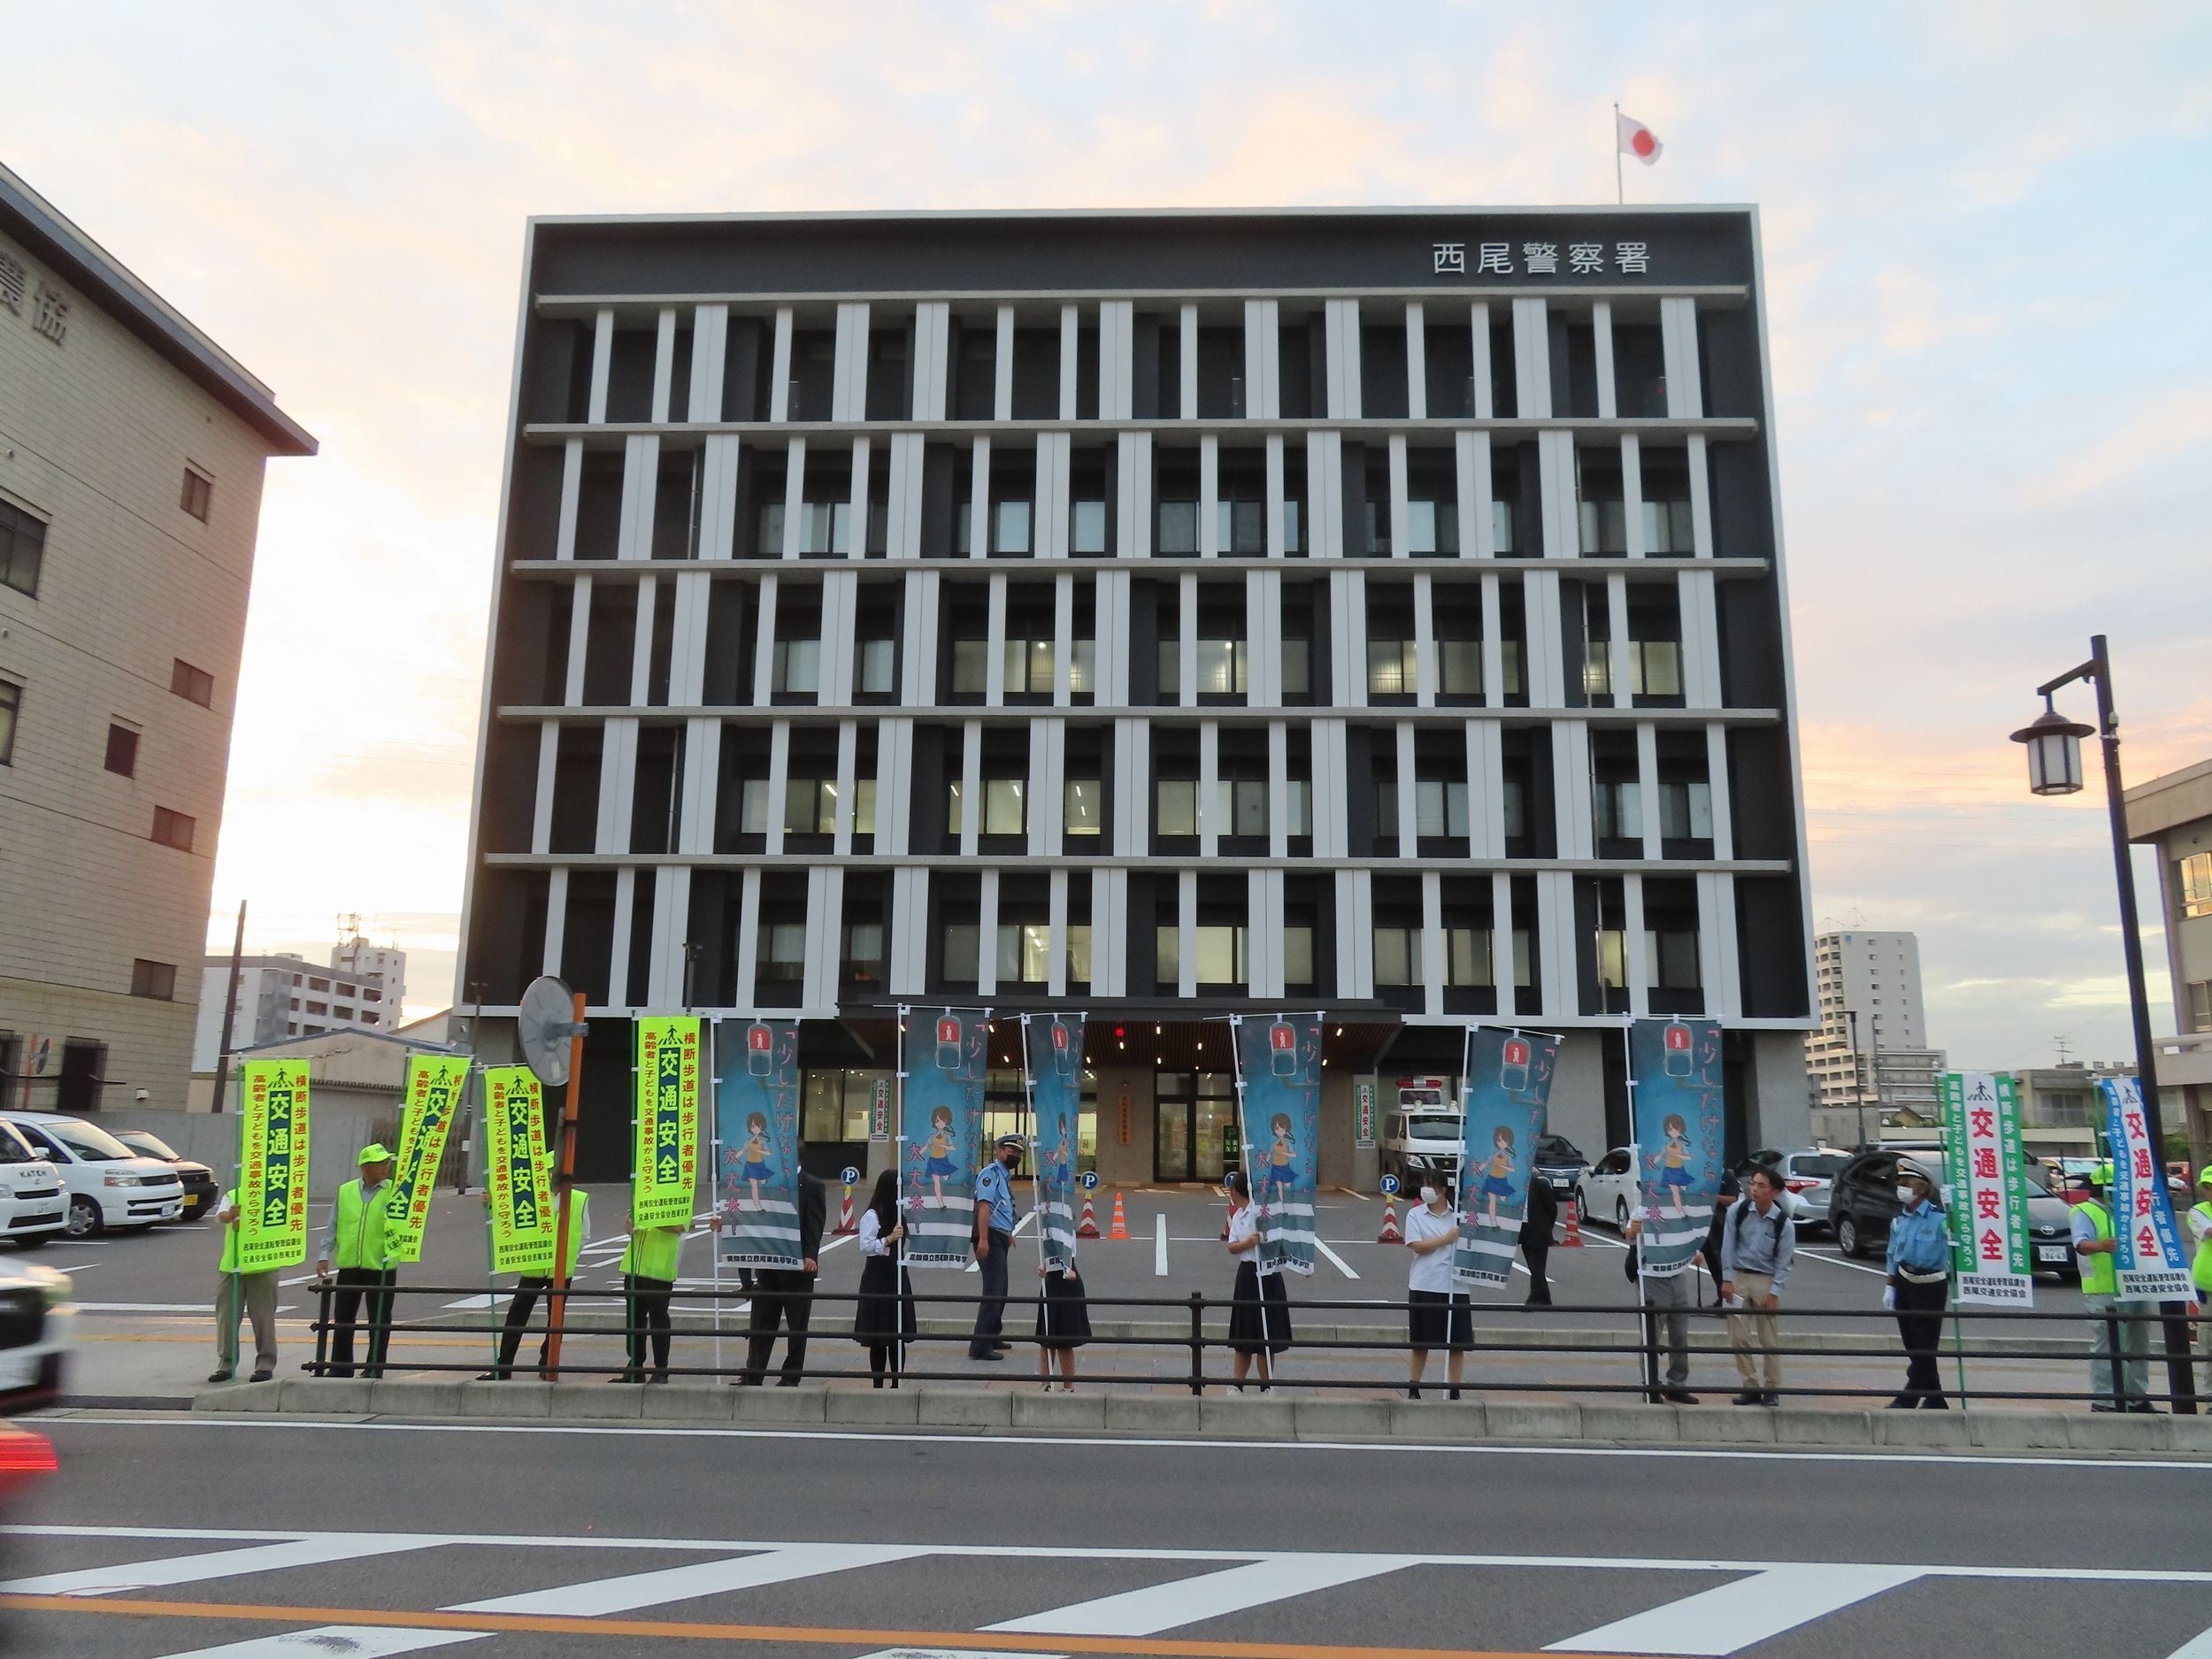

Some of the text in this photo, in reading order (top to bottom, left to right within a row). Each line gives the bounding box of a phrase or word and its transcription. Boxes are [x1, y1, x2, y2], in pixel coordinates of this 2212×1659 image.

[1432, 242, 1650, 274] 西尾警察署
[248, 1074, 265, 1236] 高齢者と子どもを交通事故から守ろう
[267, 1094, 289, 1225] 交通安全
[290, 1075, 307, 1231] 横断歩道は歩行者優先
[494, 1082, 511, 1239] 高齢者と子どもを交通事故から守ろう
[511, 1100, 535, 1227] 交通安全
[528, 1082, 553, 1233] 横断歩道は歩行者優先
[642, 1032, 657, 1194] 高齢者と子どもを交通事故から守ろう
[658, 1051, 679, 1181] 交通安全
[681, 1033, 695, 1189] 横断歩道は歩行者優先
[845, 1170, 856, 1183] P
[1084, 1175, 1095, 1187] P
[1384, 1178, 1395, 1191] P
[1970, 1107, 2003, 1261] 交通安全
[2125, 1110, 2159, 1257] 交通安全
